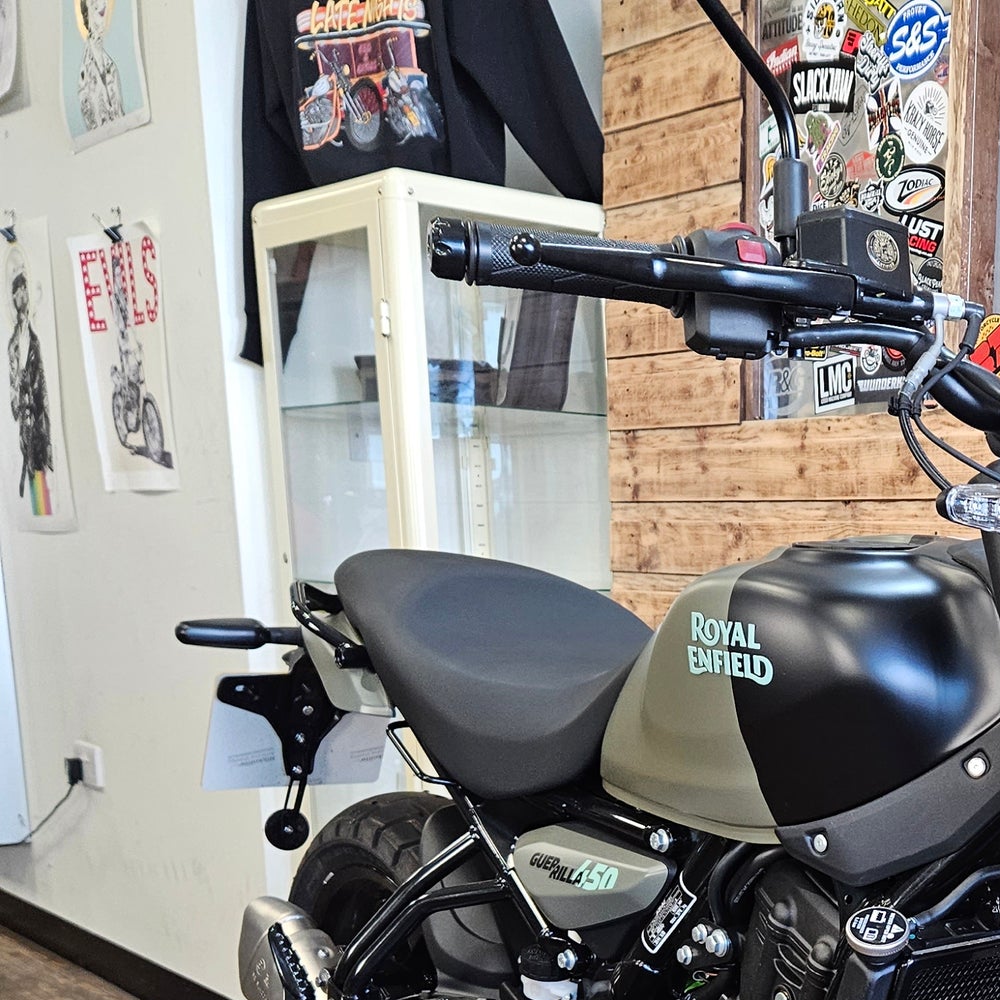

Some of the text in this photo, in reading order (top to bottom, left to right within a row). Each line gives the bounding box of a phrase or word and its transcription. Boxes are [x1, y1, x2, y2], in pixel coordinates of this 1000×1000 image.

[889, 15, 939, 60] S&S
[793, 67, 854, 107] SLACKJAW
[904, 100, 926, 131] KRAZY
[922, 122, 944, 154] HORSE
[897, 179, 934, 202] ZODIAC
[909, 235, 937, 253] CING
[819, 361, 852, 398] LMC
[691, 612, 760, 649] ROYAL
[687, 646, 773, 685] ENFIELD
